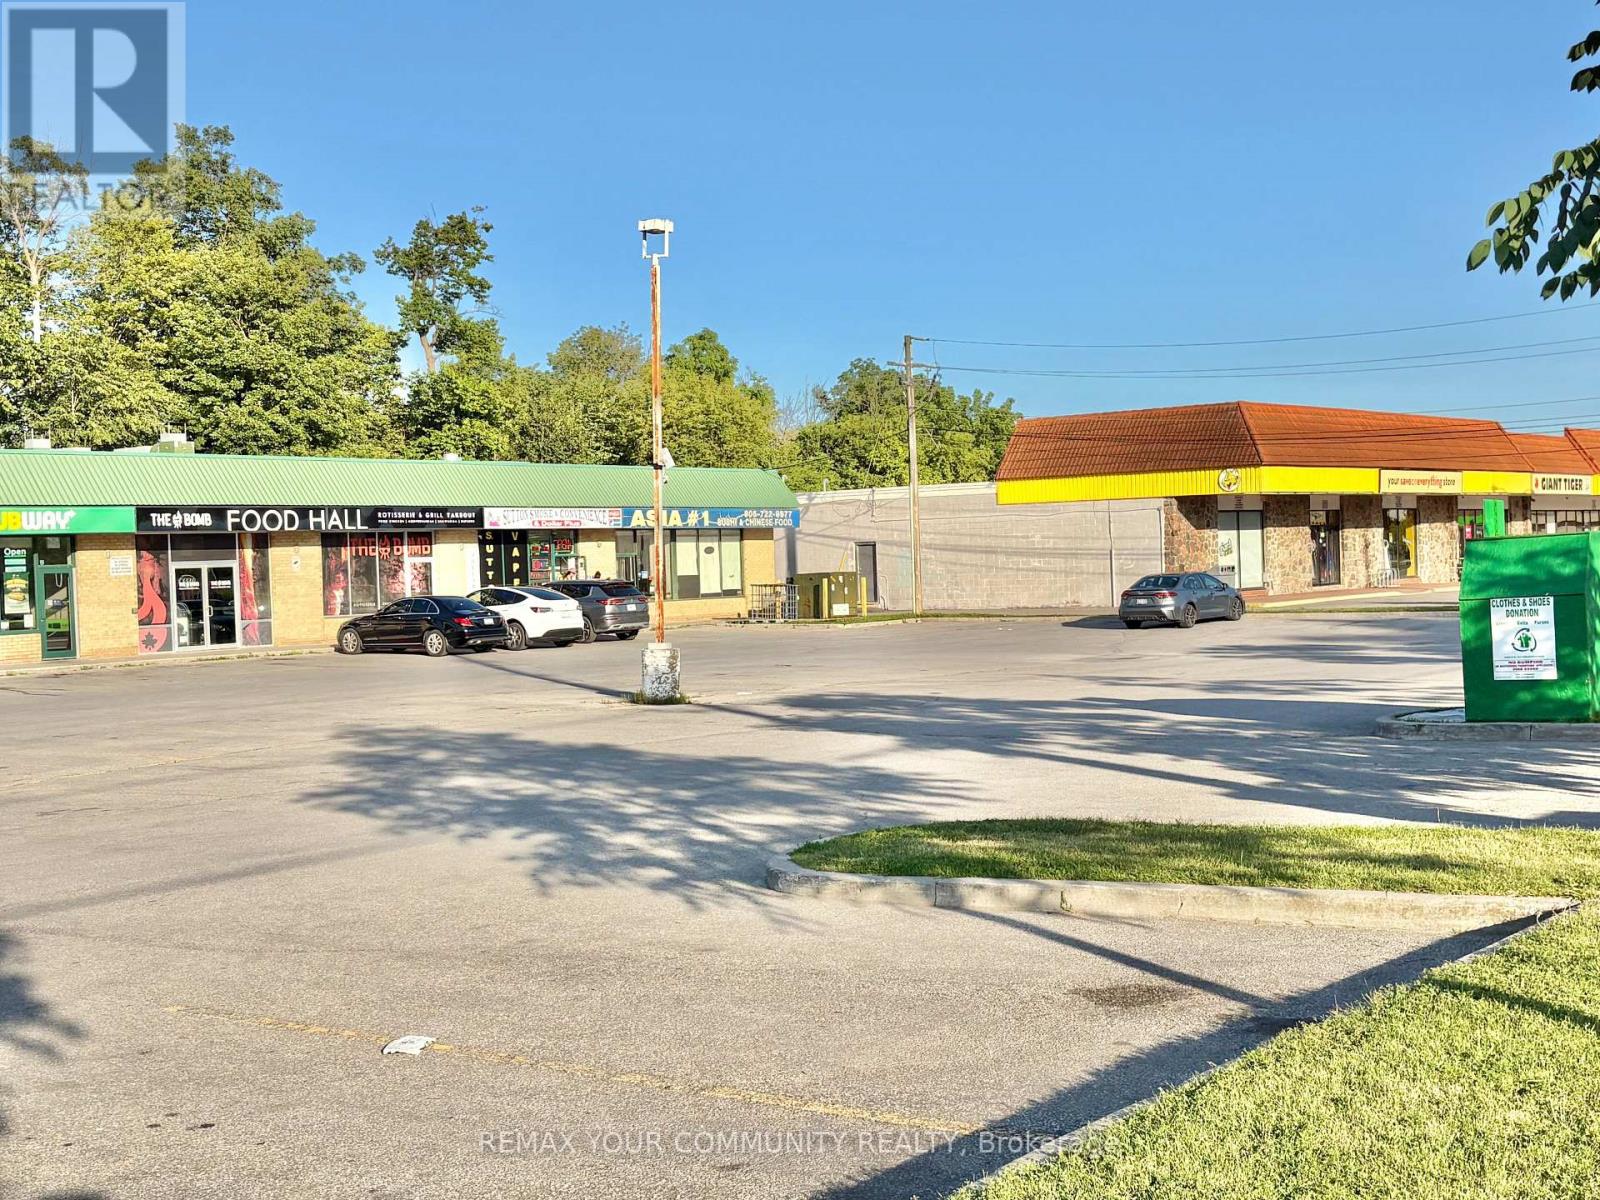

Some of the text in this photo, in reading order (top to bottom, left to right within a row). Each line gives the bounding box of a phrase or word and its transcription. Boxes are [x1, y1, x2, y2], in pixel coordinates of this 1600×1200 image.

[1541, 477, 1583, 491] GIANT TIGER
[150, 512, 213, 527] THE BOMB
[226, 508, 369, 531] FOOD HALL
[377, 511, 416, 519] ROTISSERIE
[425, 511, 444, 519] GRILL
[630, 509, 683, 527] ASIA
[686, 509, 709, 527] #1
[717, 518, 738, 527] SUSHI
[745, 518, 773, 527] CHINESE
[774, 518, 793, 526] FOOD
[4, 547, 27, 556] Open
[1491, 597, 1551, 608] CLOTHES & SHOES
[1505, 608, 1539, 618] DONATION
